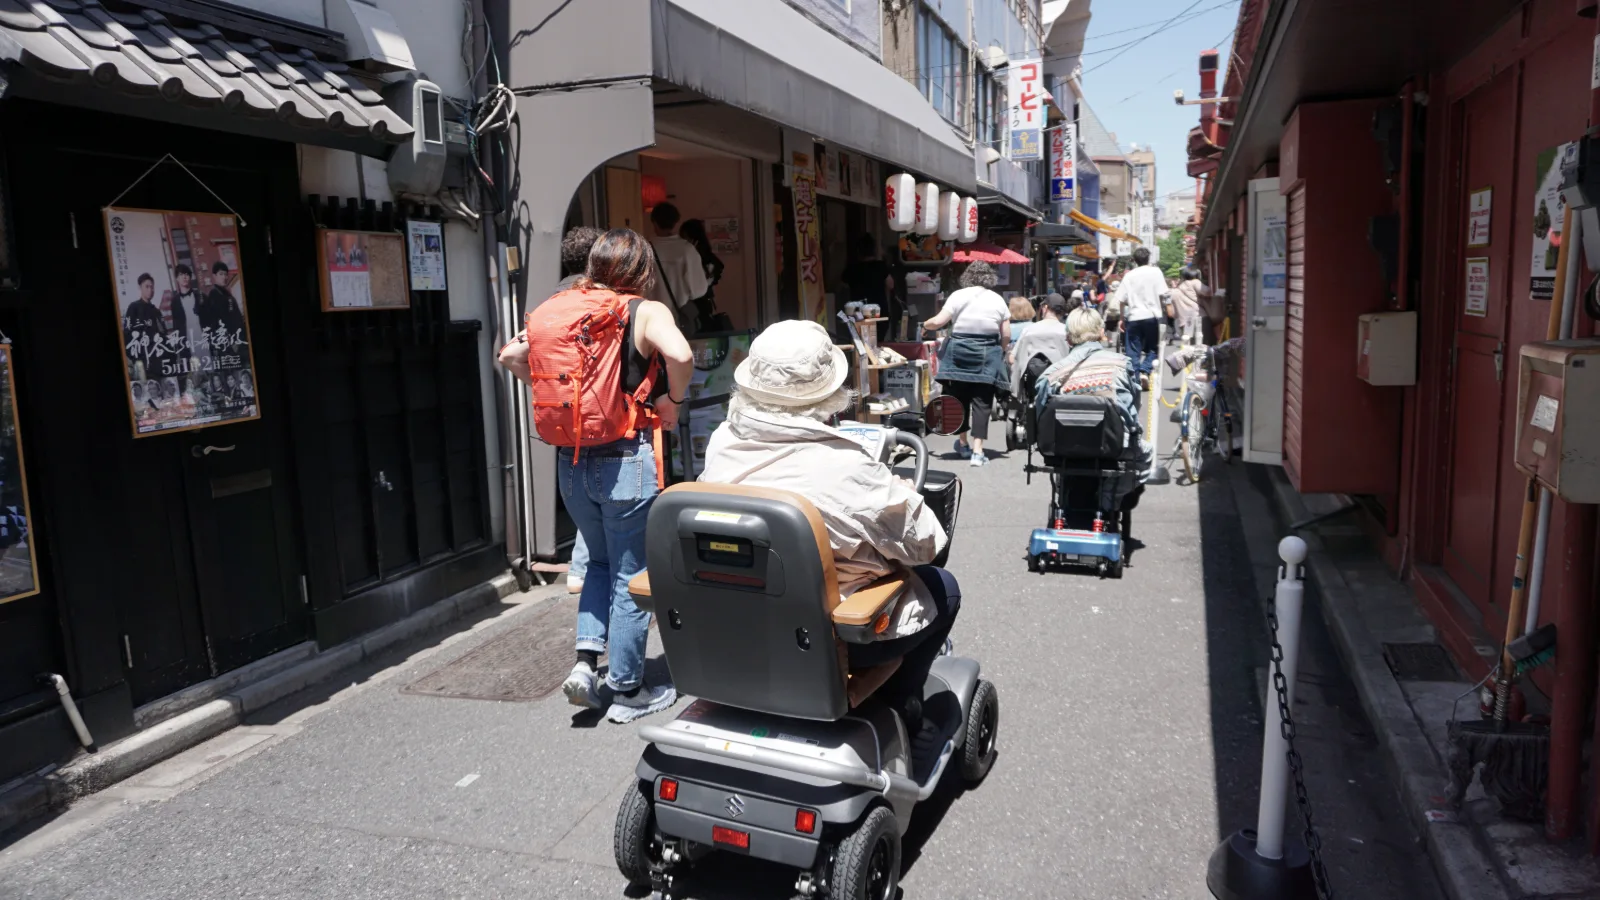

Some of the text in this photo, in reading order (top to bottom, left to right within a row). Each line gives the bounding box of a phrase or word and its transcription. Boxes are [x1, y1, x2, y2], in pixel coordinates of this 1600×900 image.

[1020, 63, 1037, 122] コーヒー
[1052, 128, 1064, 178] オムライス
